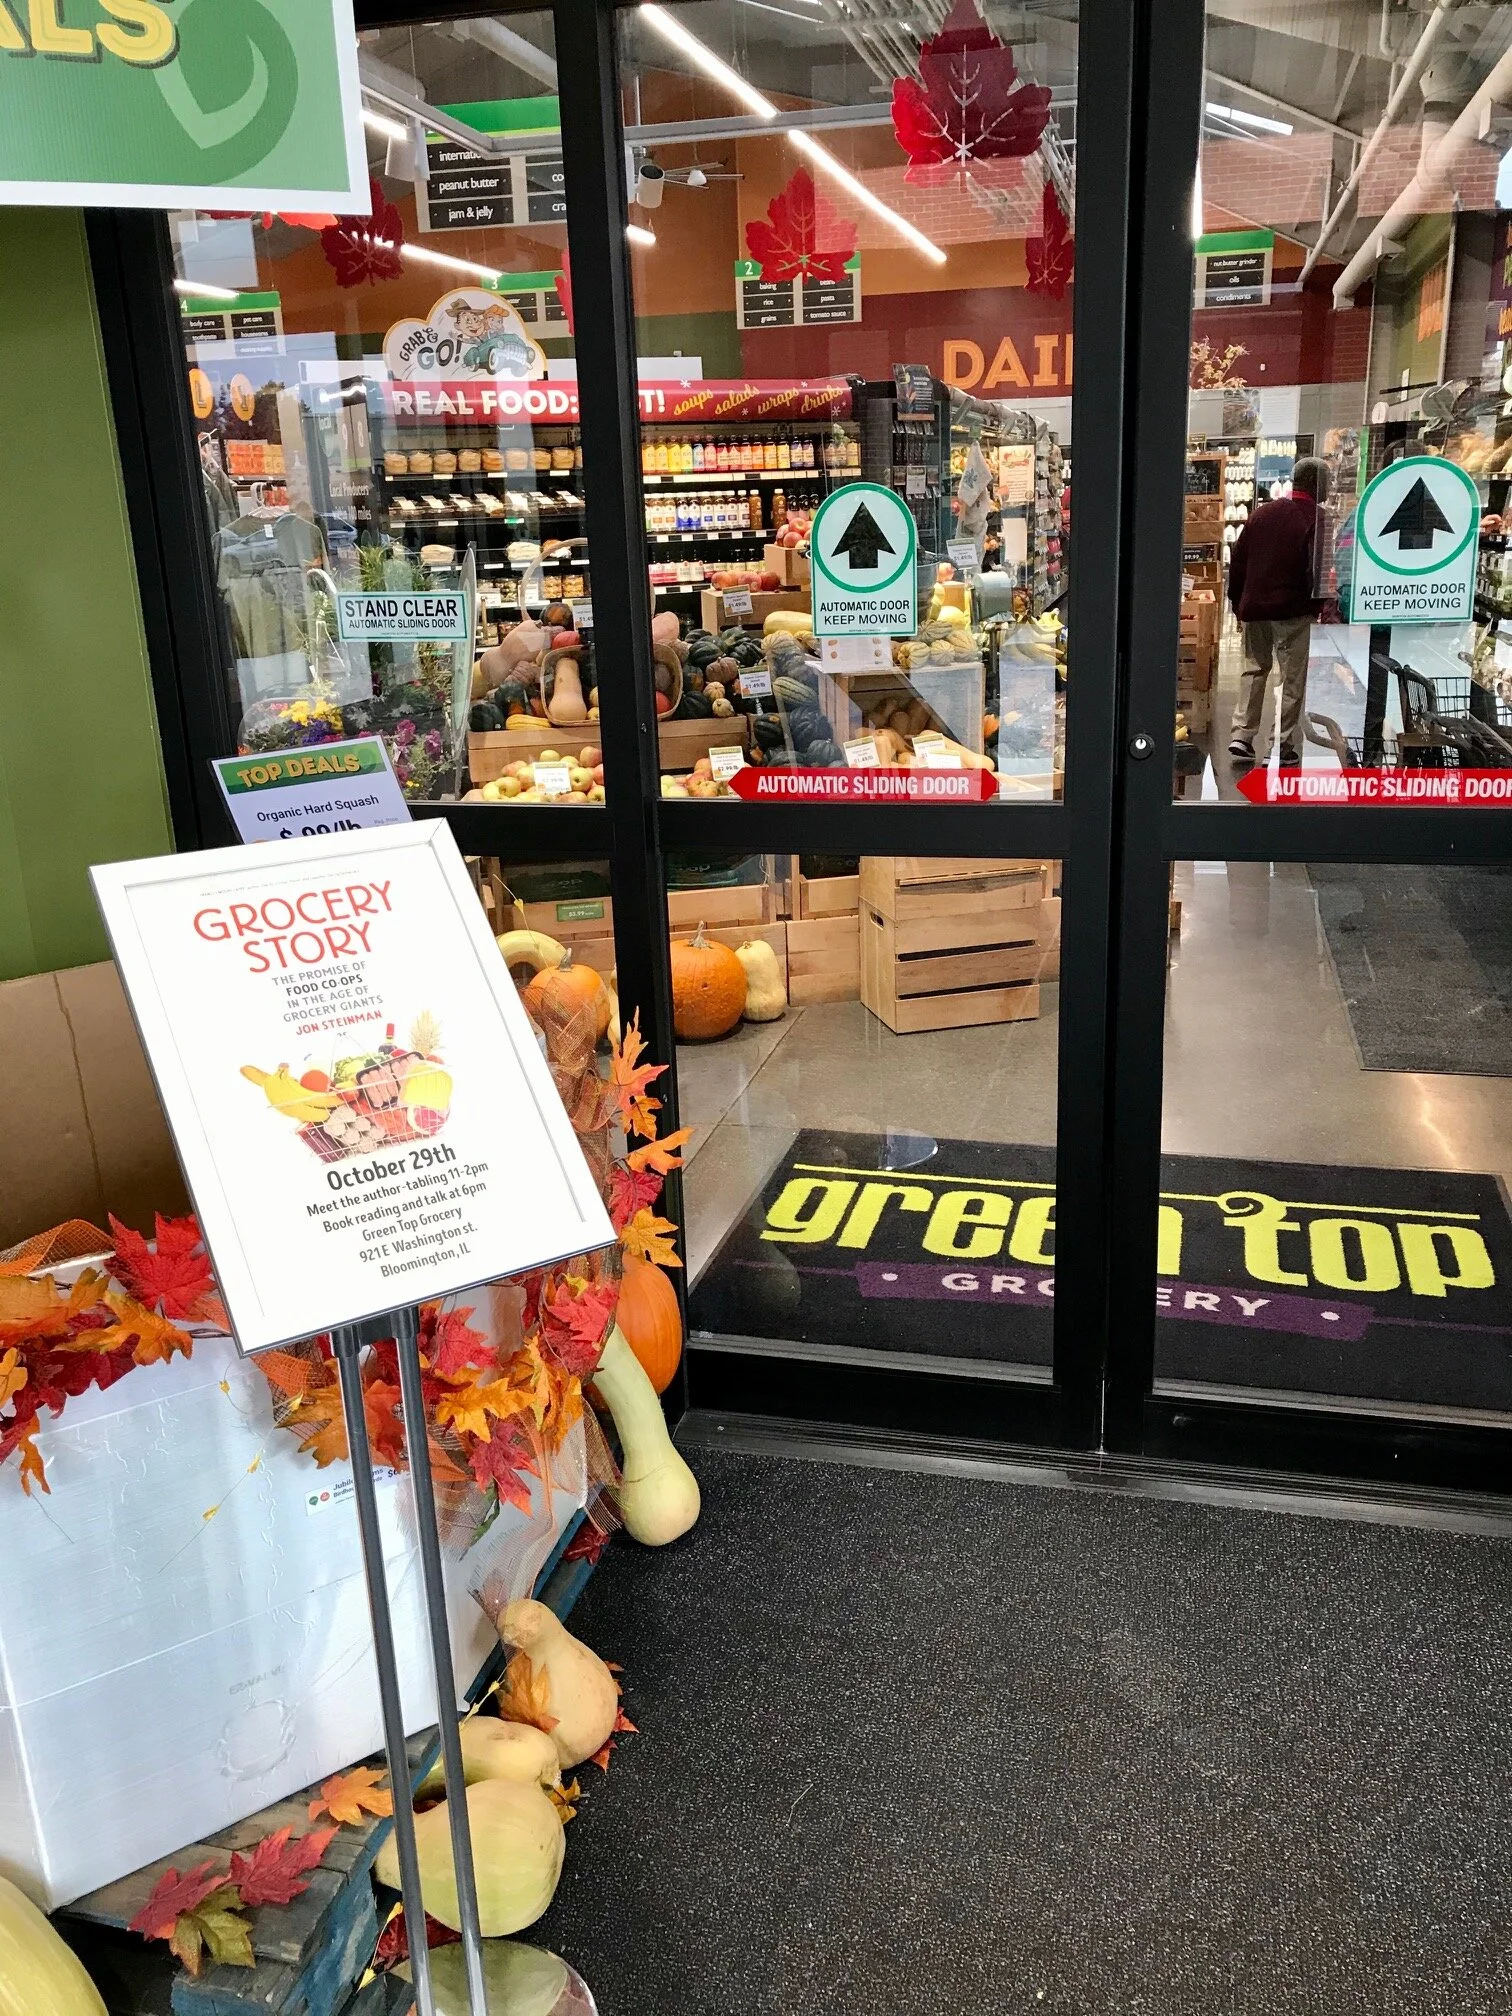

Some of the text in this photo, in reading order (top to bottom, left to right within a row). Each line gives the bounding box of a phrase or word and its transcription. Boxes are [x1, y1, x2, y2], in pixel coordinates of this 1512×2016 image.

[439, 177, 499, 193] peanut butter
[448, 206, 493, 222] jam & jelly
[744, 262, 754, 275] 2
[491, 277, 498, 289] 3
[759, 283, 777, 291] baking
[180, 300, 188, 312] 4
[1216, 293, 1252, 302] condiments
[761, 315, 777, 323] grains
[399, 327, 438, 362] GRAB &
[417, 338, 464, 370] GO!
[392, 390, 474, 415] REAL
[481, 390, 579, 415] FOOD:
[674, 384, 843, 415] soups salads wraps drinks
[1361, 583, 1466, 596] AUTOMATIC DOOR
[345, 600, 458, 617] STAND CLEAR
[820, 600, 910, 612] AUTOMATIC DOOR
[1364, 598, 1461, 610] KEEP MOVING
[349, 619, 456, 628] AUTOMATIC SLIDING DOOR
[824, 614, 907, 625] KEEP MOVING
[237, 753, 361, 788] TOP DEALS
[757, 775, 969, 795] AUTOMATIC SLIDING DOOR
[1270, 777, 1378, 796] AUTOMATIC
[1383, 778, 1459, 797] SLIDING
[257, 795, 379, 822] Organic Hard Squash
[193, 880, 392, 942] GROCERY
[243, 921, 372, 973] STORY
[272, 960, 367, 987] THE PROMISE OF
[286, 982, 319, 997] FOOD
[287, 985, 369, 1009] IN THE AGE OF
[283, 994, 384, 1023] GROCERY GIANTS
[296, 1010, 382, 1036] JON STEINMAN
[326, 1143, 457, 1191] October 29th
[306, 1161, 489, 1217] Meet the author-tabling 11-2pm
[323, 1182, 487, 1233] Book reading and talk at 6pm
[362, 1206, 463, 1242] Green Top Grocery
[392, 1227, 463, 1255] Washington
[462, 1220, 478, 1233] st.
[1224, 1191, 1495, 1298] top
[381, 1242, 471, 1278] Bloomington, IL
